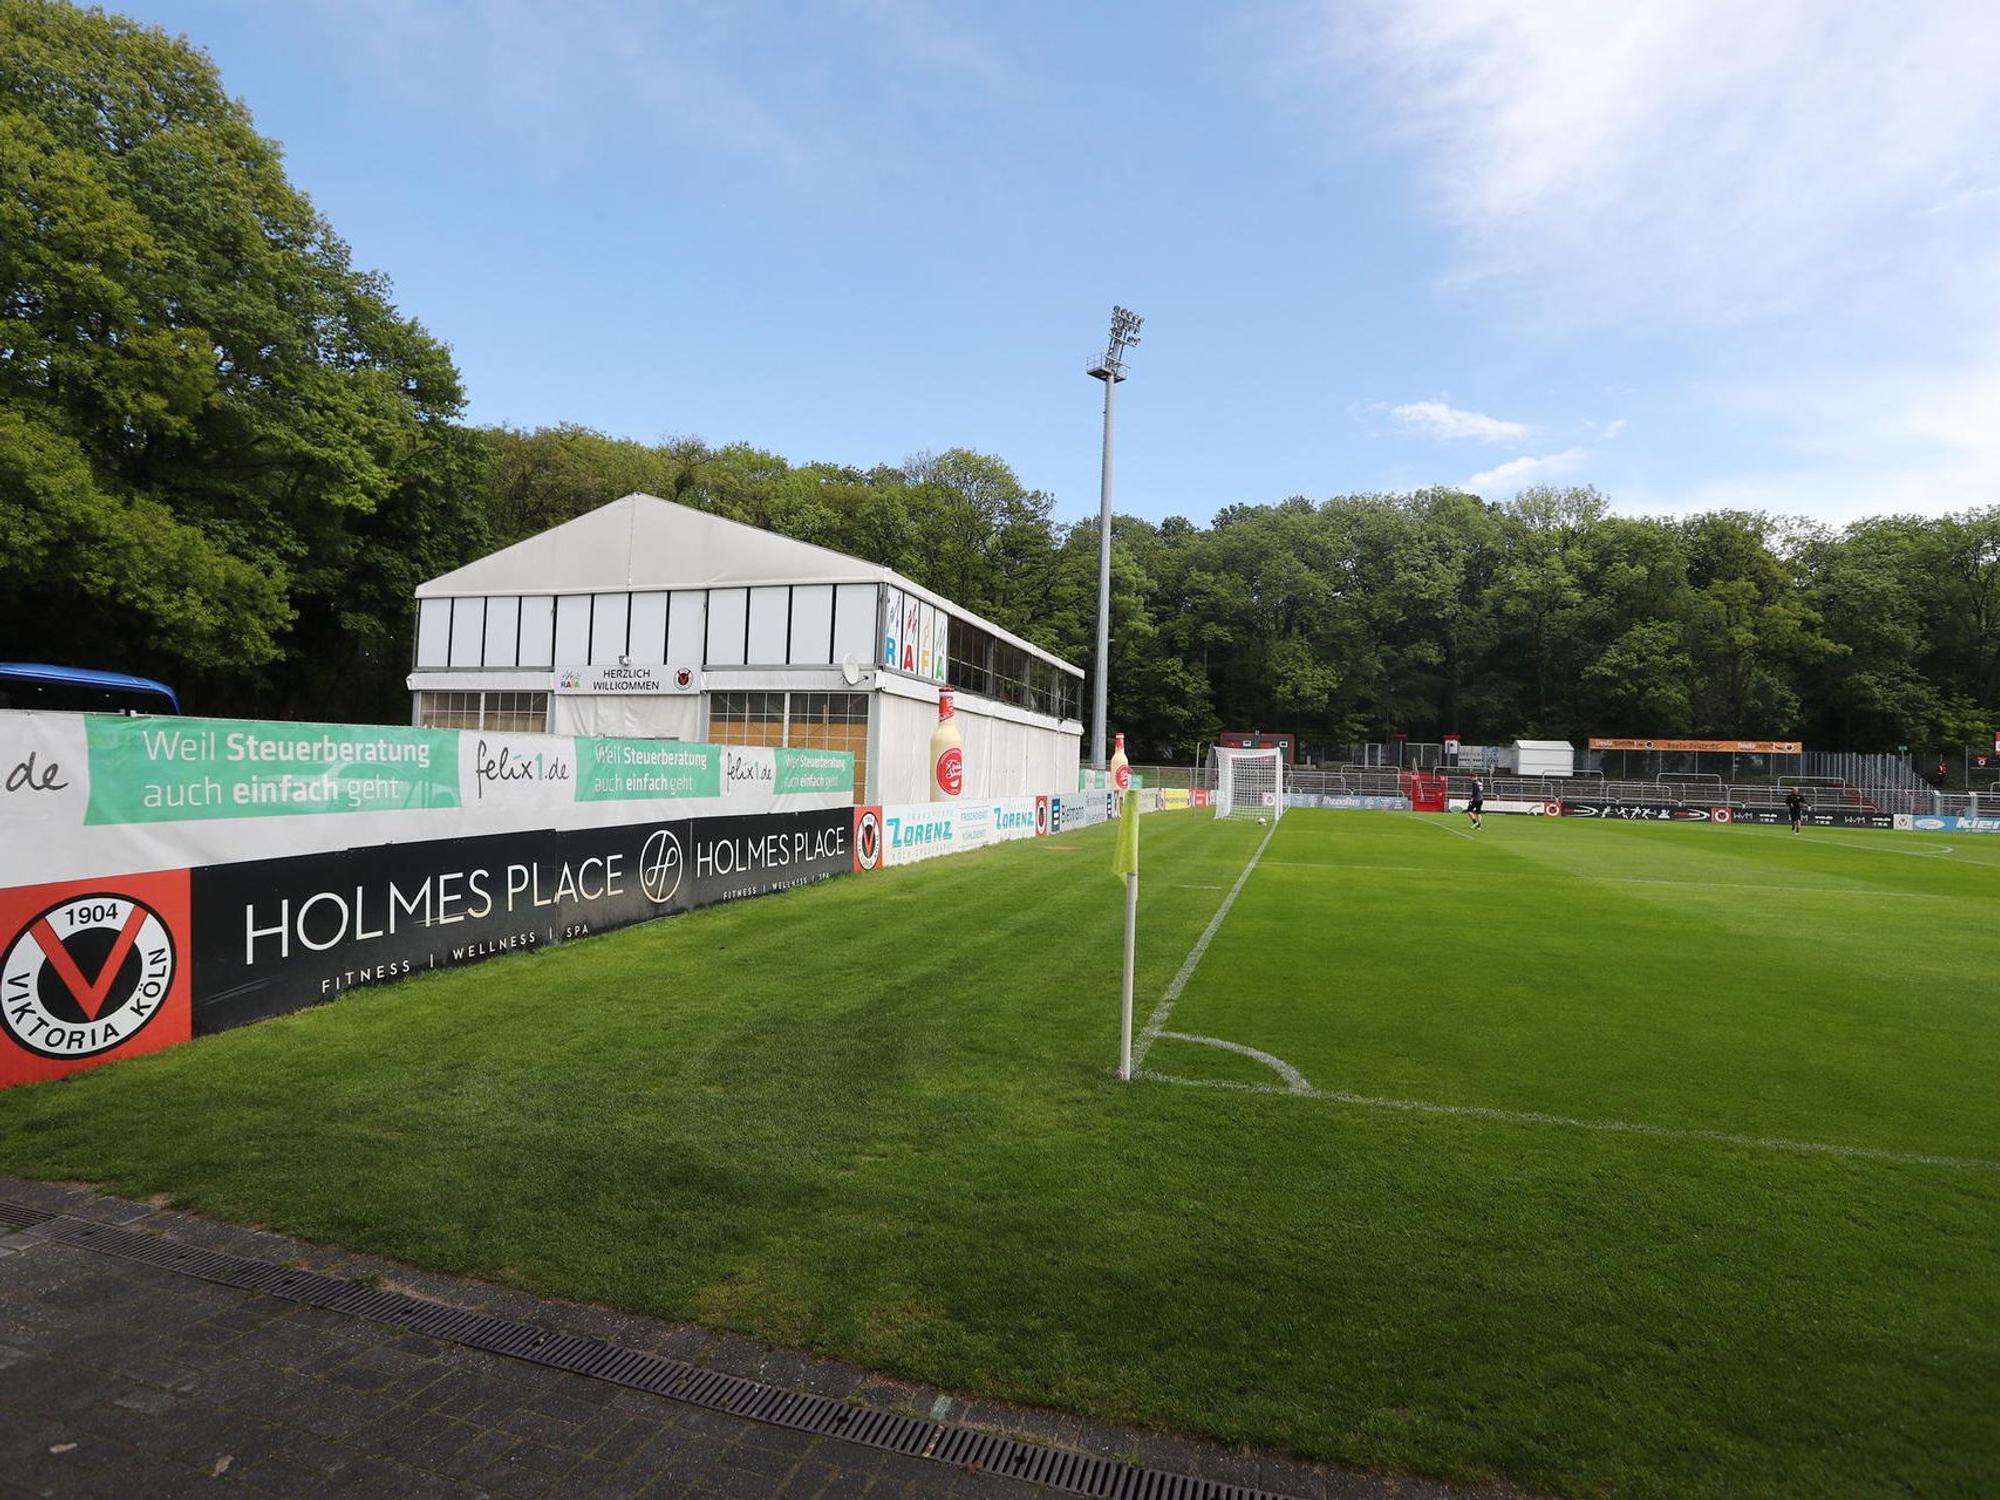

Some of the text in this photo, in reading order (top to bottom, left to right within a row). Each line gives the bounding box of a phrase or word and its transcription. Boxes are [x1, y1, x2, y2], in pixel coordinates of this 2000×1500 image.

[593, 681, 660, 691] WILLKOMMEN
[603, 669, 650, 678] HERZLICH
[143, 730, 430, 767] Weil Steuerberatung
[594, 744, 707, 770] Weil Steuerberatung
[476, 739, 570, 799] felix1.de
[593, 771, 694, 796] auch einfach geht
[143, 774, 399, 807] auch einfach geht
[696, 833, 790, 879] HOLMES
[795, 826, 845, 863] PLACE
[723, 887, 757, 901] FITNESS
[772, 877, 808, 890] WELLNESS
[65, 902, 119, 927] 1904
[245, 854, 624, 966] HOLMES PLACE
[322, 924, 589, 994] FITNESS WELLNESS SPA
[7, 946, 167, 1050] VIKTORIA KÖLN
